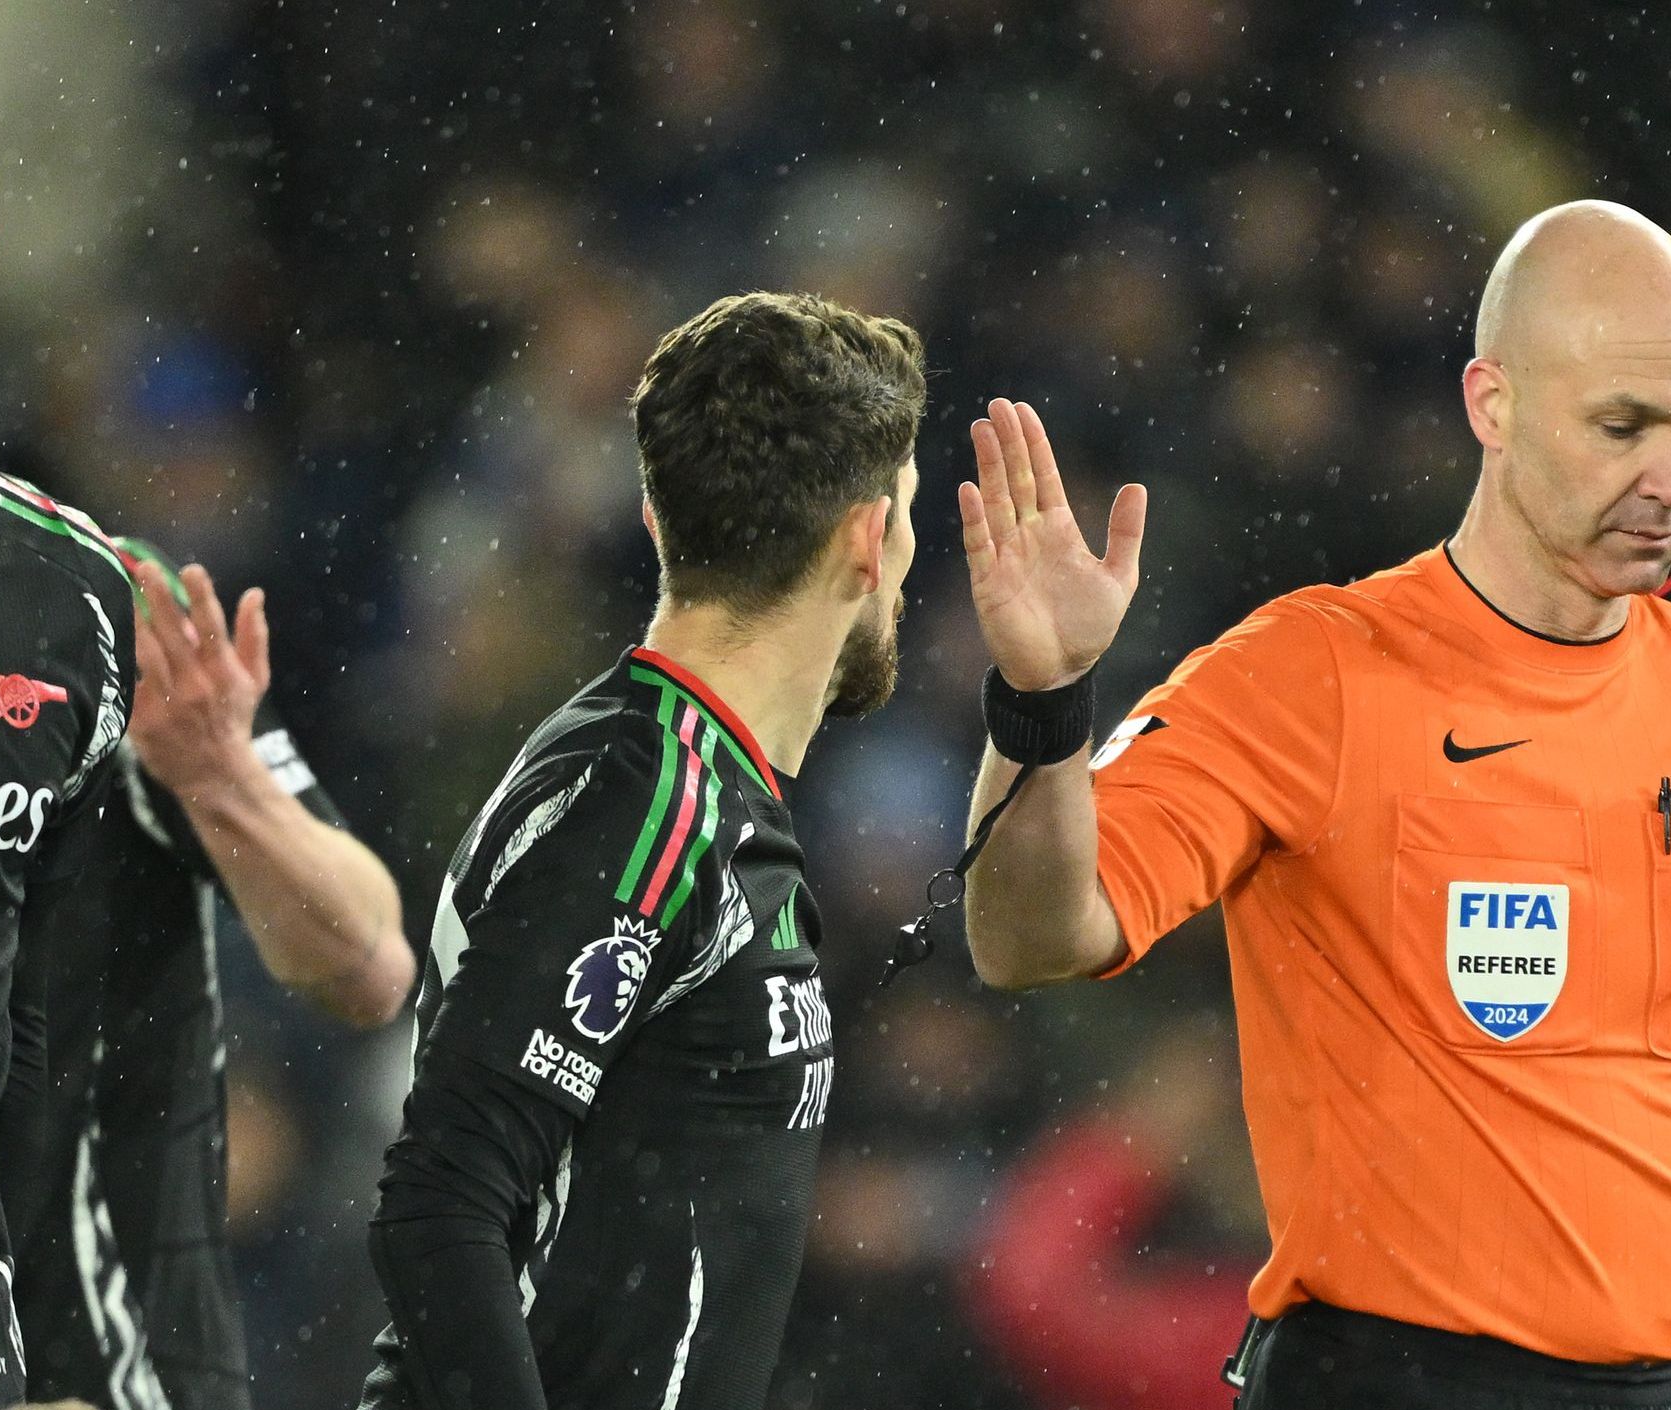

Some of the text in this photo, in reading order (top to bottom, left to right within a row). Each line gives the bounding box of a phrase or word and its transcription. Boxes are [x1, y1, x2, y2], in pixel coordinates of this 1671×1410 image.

[1459, 893, 1557, 930] FIFA
[1458, 955, 1556, 976] REFEREE
[1483, 1007, 1529, 1025] 2024
[528, 1028, 565, 1062] No
